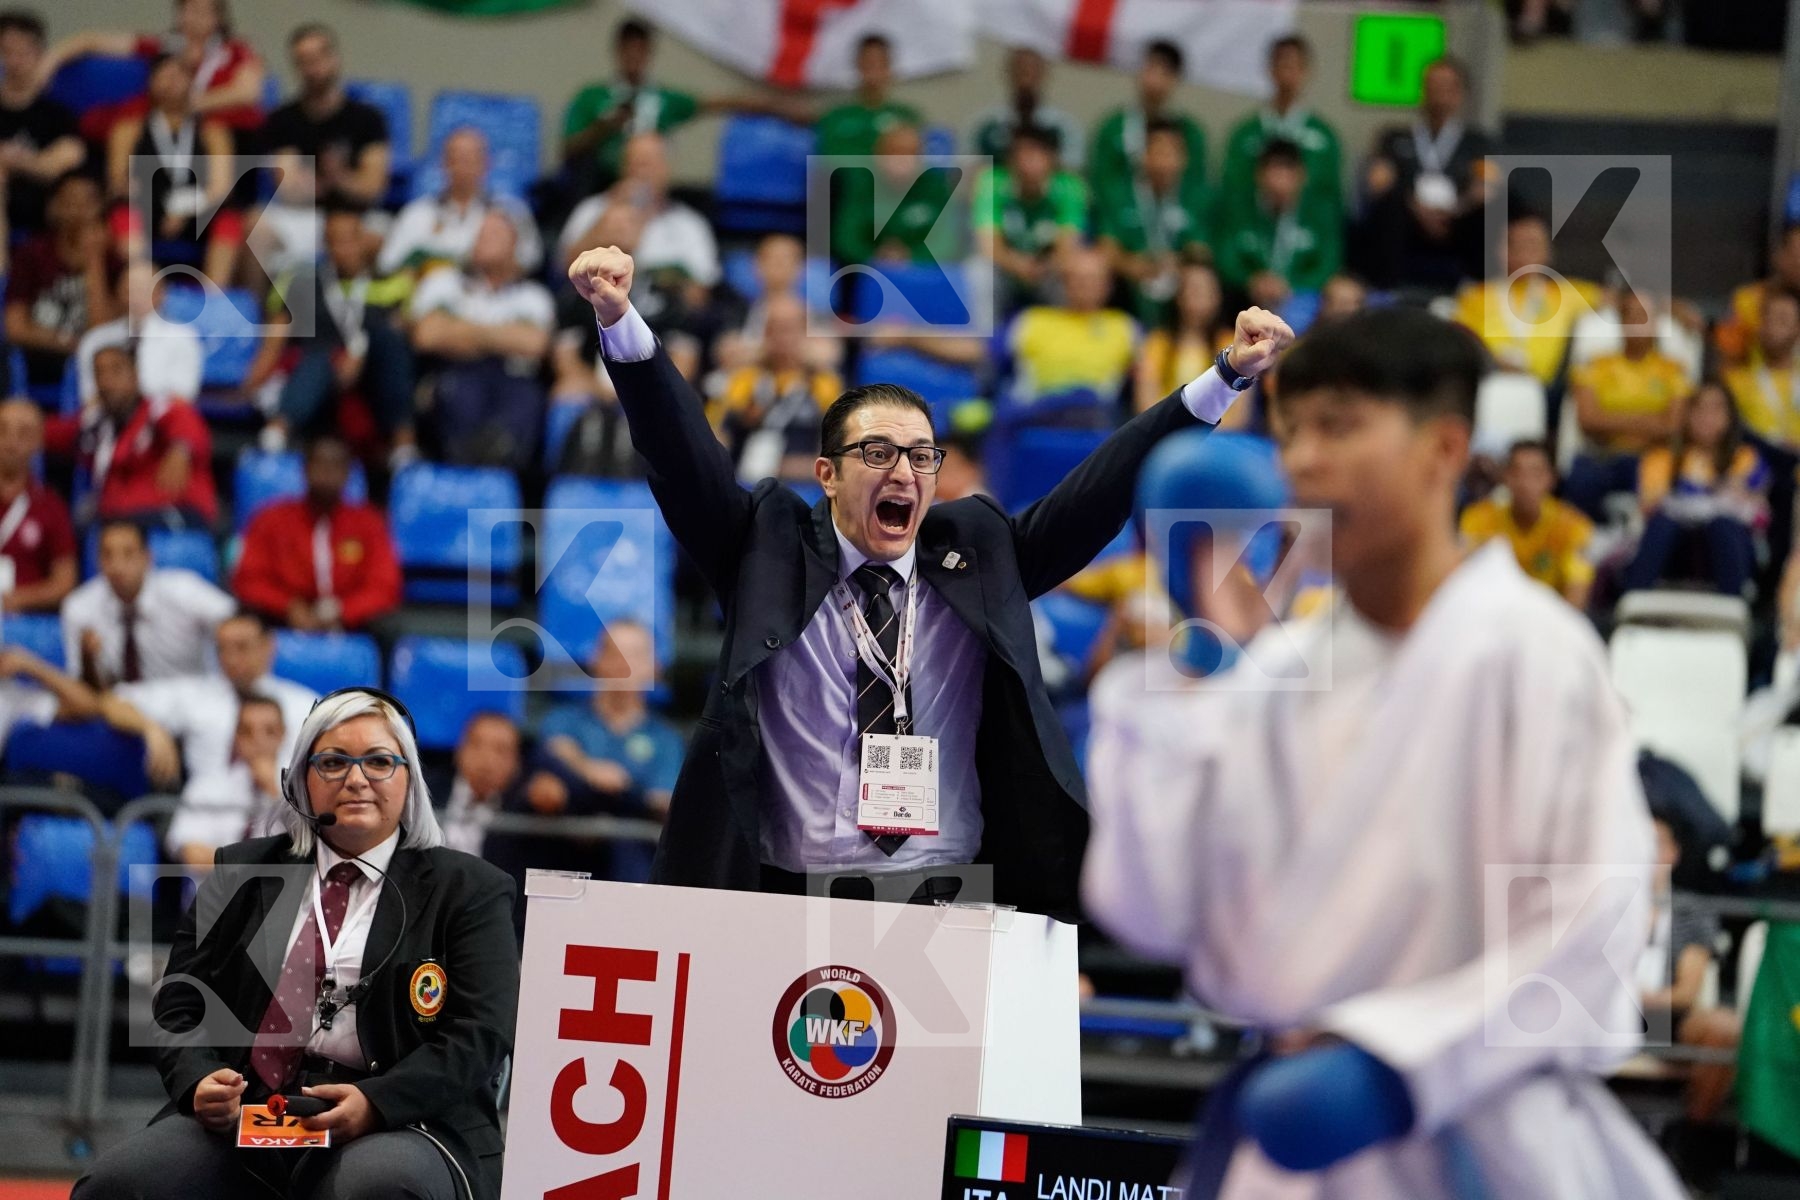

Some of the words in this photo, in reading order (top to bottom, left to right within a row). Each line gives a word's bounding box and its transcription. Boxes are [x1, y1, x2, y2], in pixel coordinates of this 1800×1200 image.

[820, 969, 861, 983] WORLD
[805, 1017, 864, 1047] WKF
[782, 1057, 816, 1092] KARATE
[819, 1064, 882, 1096] FEDERATION
[250, 1137, 298, 1145] AKA
[1037, 1173, 1111, 1200] LANDI
